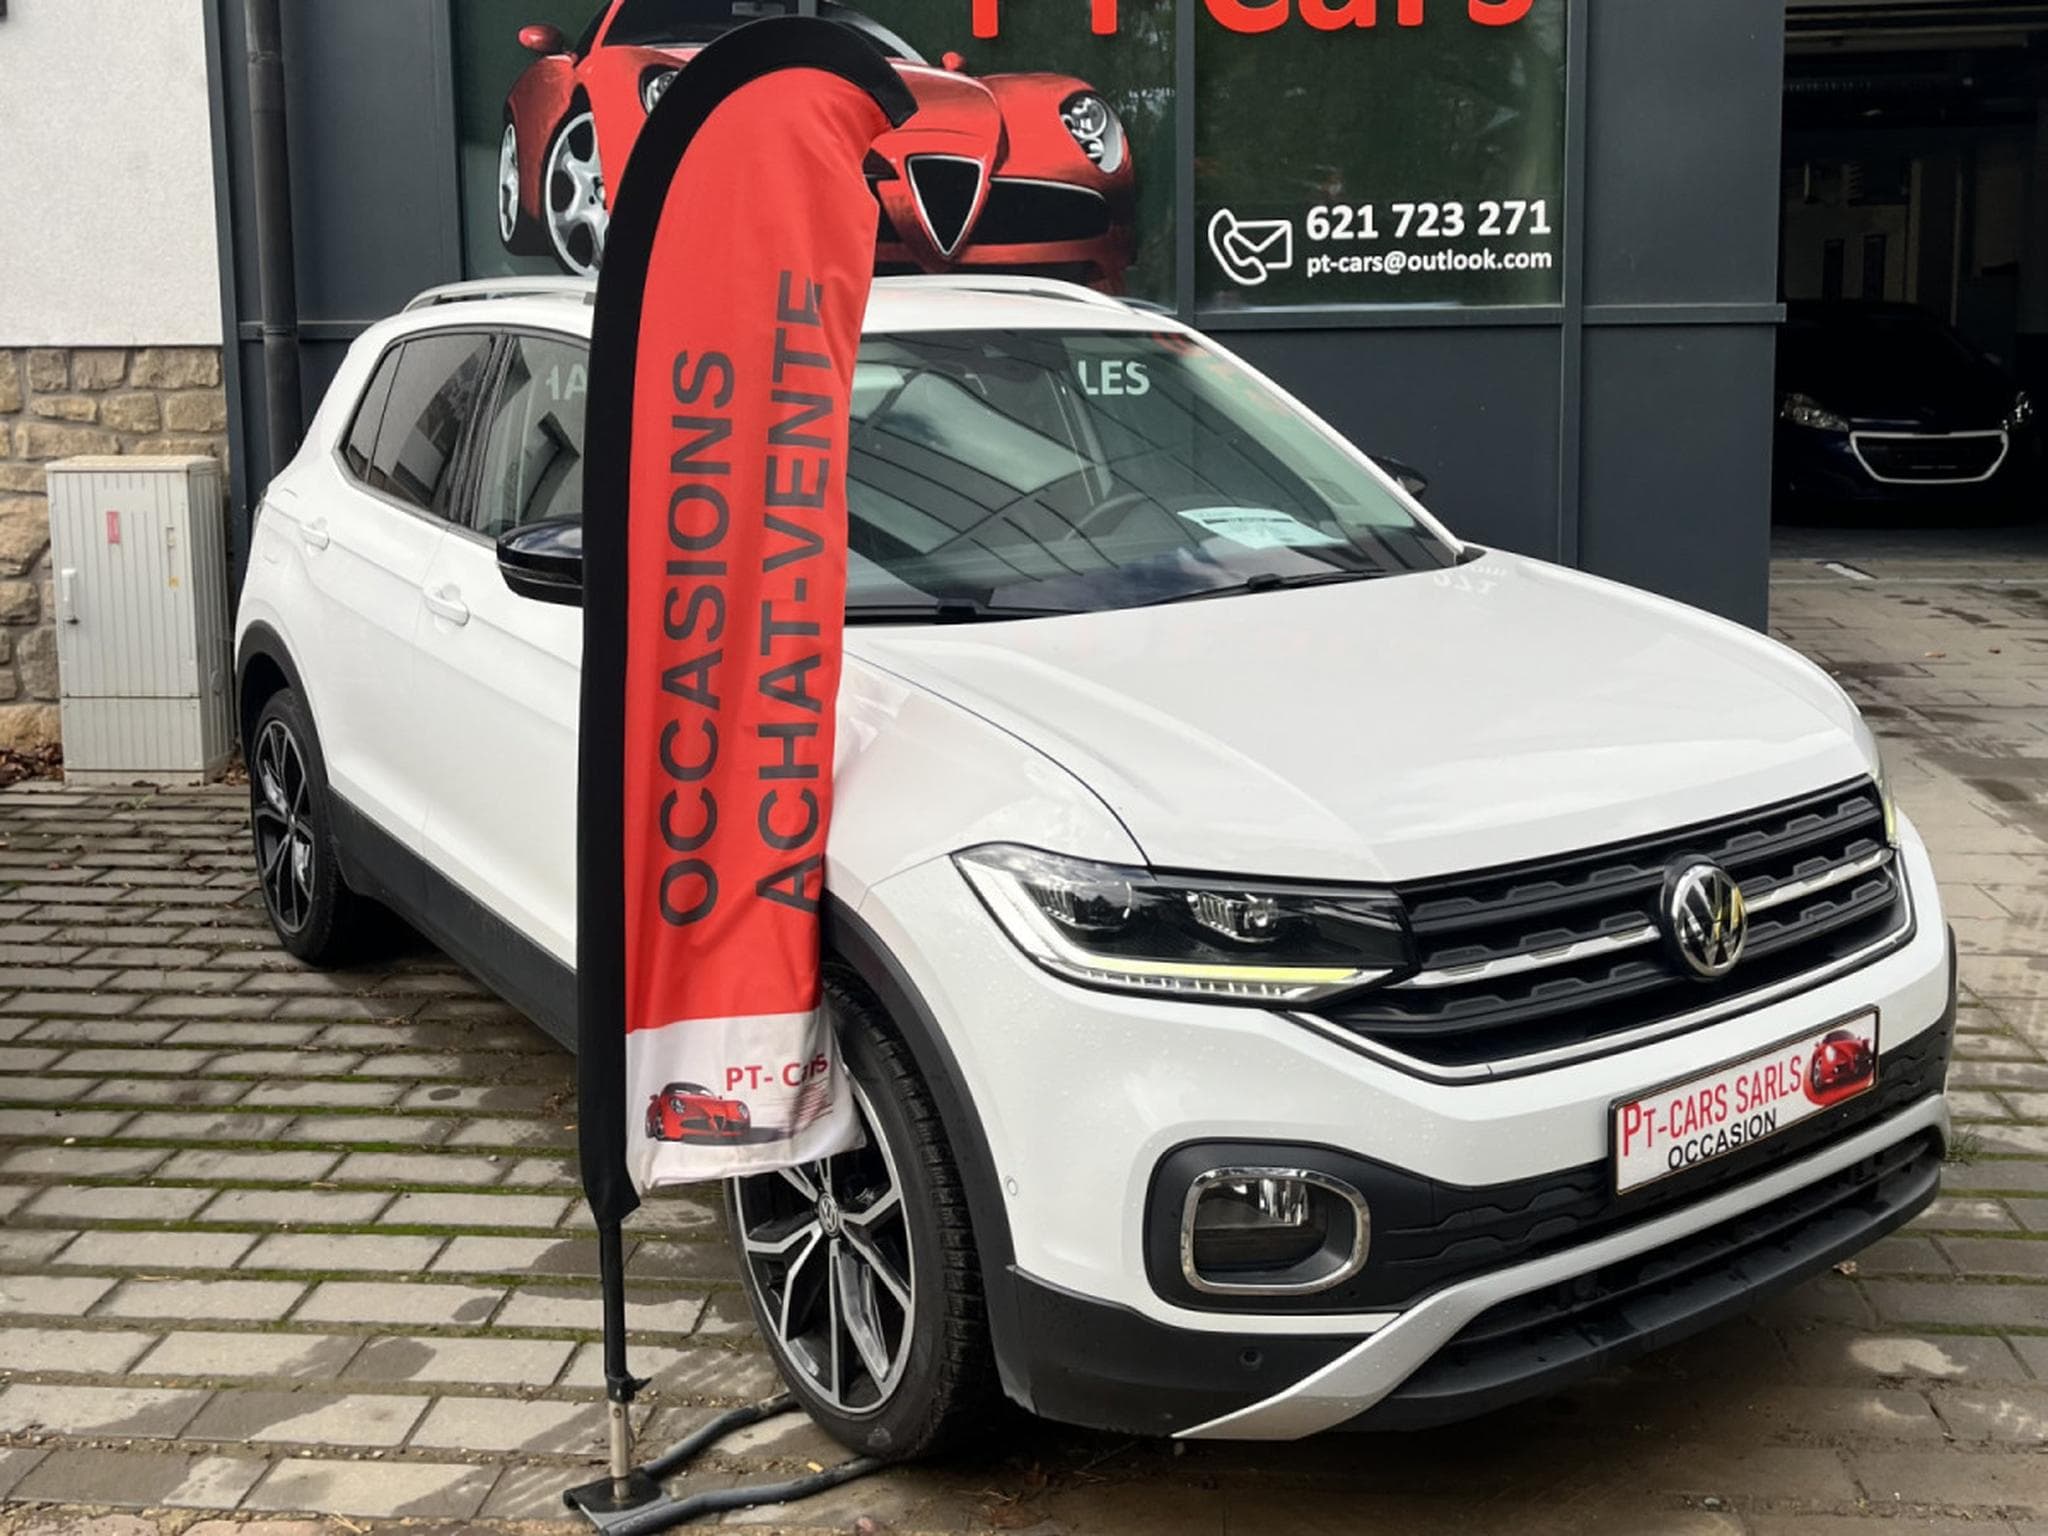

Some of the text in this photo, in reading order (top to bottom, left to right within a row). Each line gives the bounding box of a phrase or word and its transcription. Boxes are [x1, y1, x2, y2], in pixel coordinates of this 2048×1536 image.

[1307, 200, 1551, 240] 621 723 271
[1307, 248, 1552, 278] pt-cars@outlook.com
[756, 269, 834, 914] ACHAT-VENTE
[659, 350, 735, 928] OCCASIONS
[1736, 1055, 1802, 1114] SARLS
[1667, 1107, 1777, 1170] OCCASION
